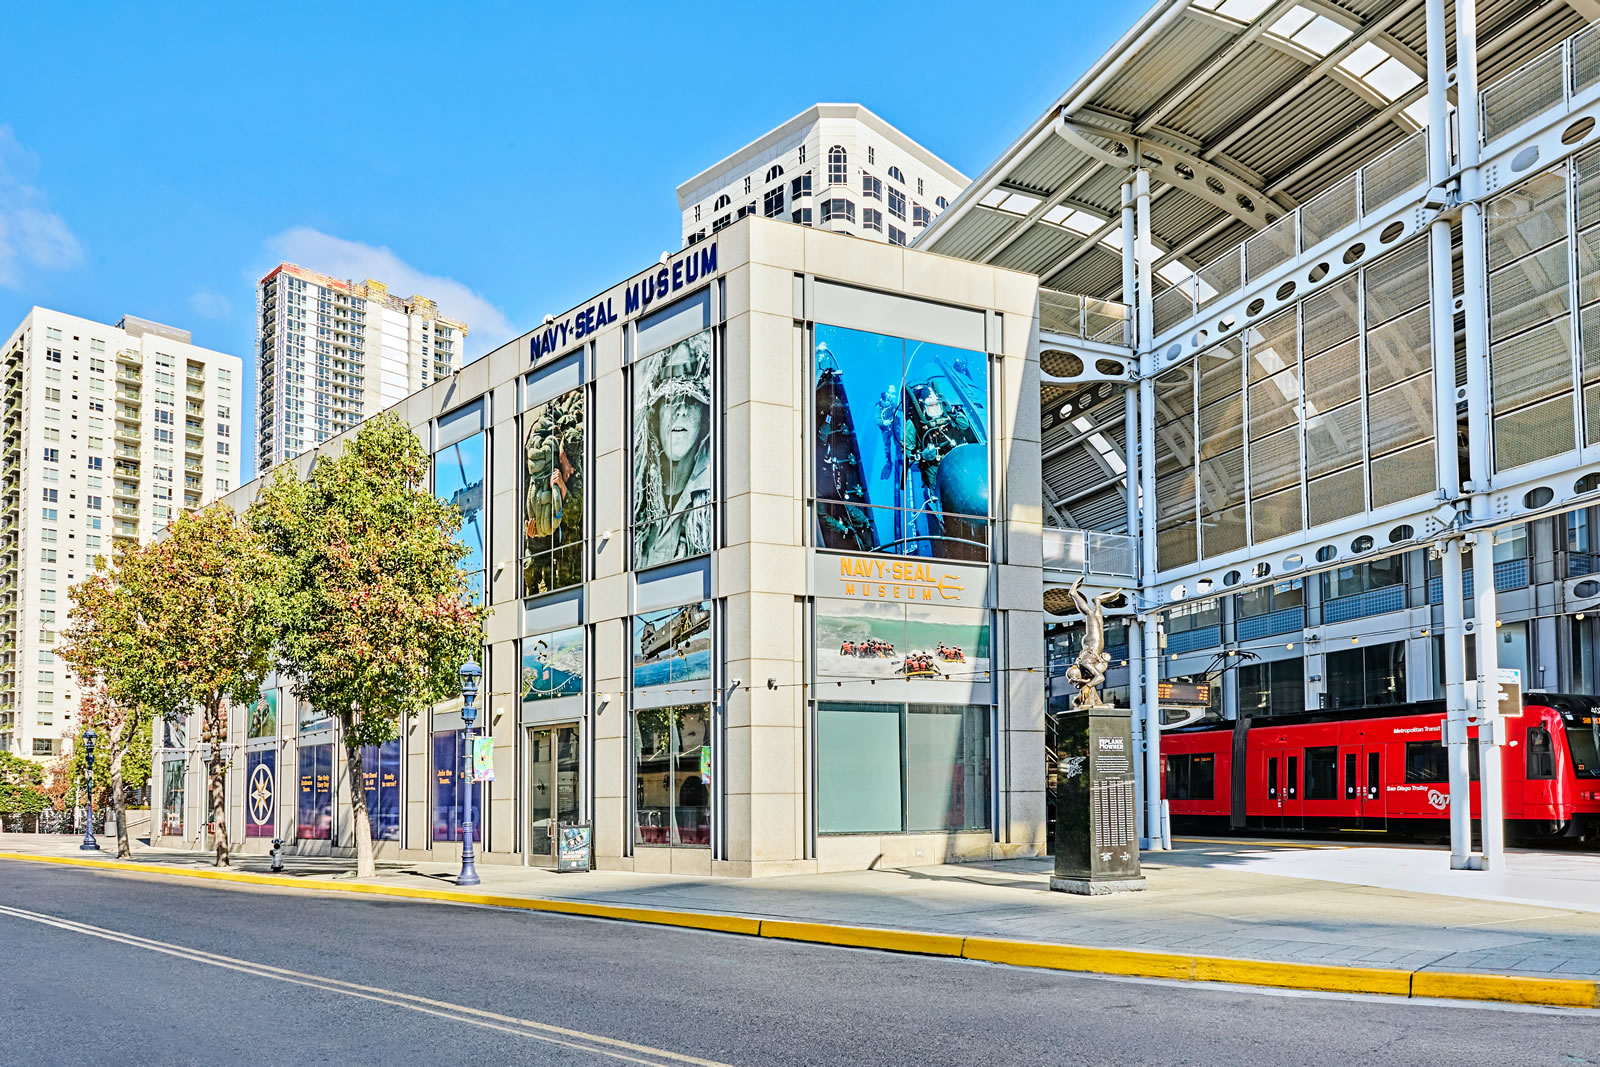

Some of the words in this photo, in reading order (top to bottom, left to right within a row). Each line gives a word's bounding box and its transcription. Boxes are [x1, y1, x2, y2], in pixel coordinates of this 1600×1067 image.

[530, 319, 570, 362] NAVY
[574, 296, 618, 341] SEAL
[625, 242, 717, 315] MUSEUM
[840, 556, 887, 578] NAVY
[892, 561, 937, 582] SEAL
[845, 582, 932, 601] MUSEUM
[1590, 706, 1600, 715] 40
[1393, 727, 1424, 735] Metropolitan
[1396, 785, 1411, 793] Diego
